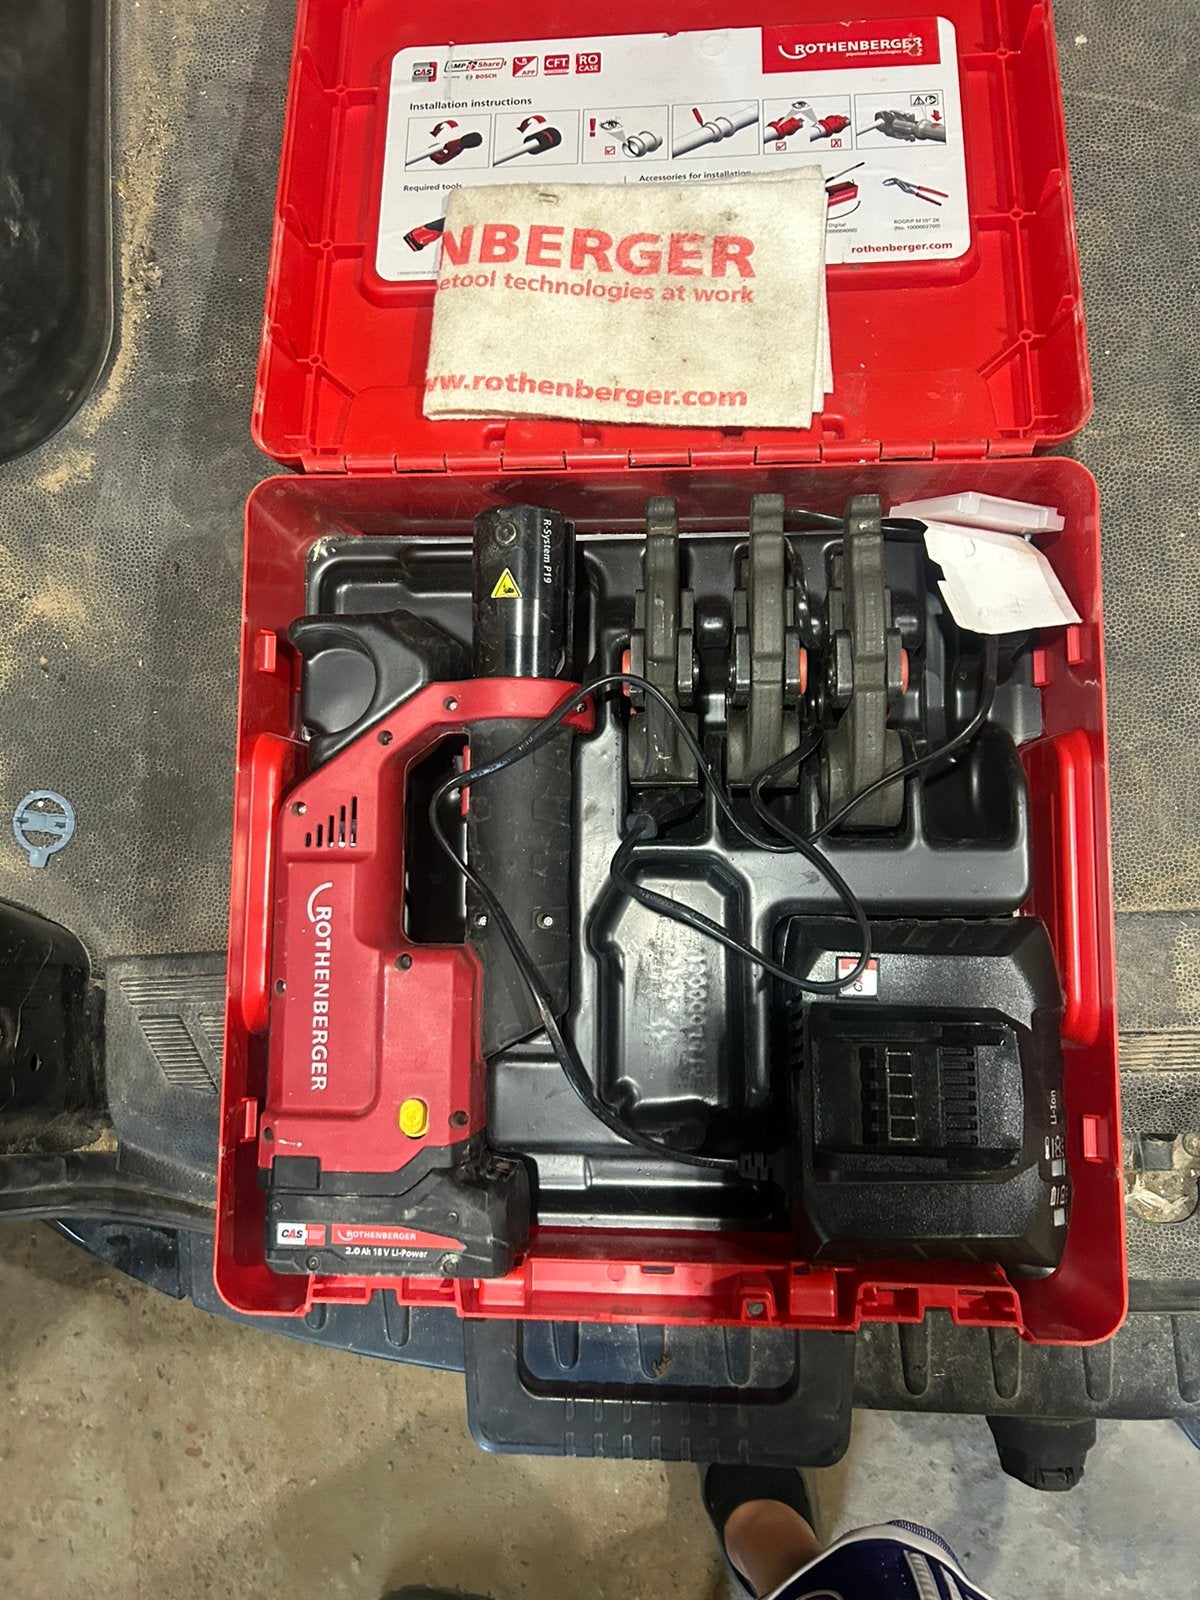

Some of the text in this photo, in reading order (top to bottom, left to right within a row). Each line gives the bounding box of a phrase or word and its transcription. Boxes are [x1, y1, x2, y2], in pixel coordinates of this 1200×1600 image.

[783, 37, 922, 58] ROTHENBERGER
[546, 57, 568, 68] CFT
[579, 54, 599, 64] RO
[413, 68, 432, 76] CAS
[409, 97, 532, 111] Installation instructions
[639, 173, 687, 182] Accessories
[703, 170, 752, 178] installation
[403, 182, 462, 192] Required tools
[851, 242, 953, 254] rothenberger.com
[439, 270, 755, 303] etool technologies at work
[541, 518, 552, 584] R-System P19
[307, 886, 334, 1092] ROTHENBERGER
[281, 1229, 303, 1239] CAS
[338, 1230, 417, 1241] ROTHENBERGER
[345, 1246, 360, 1255] 2.0
[361, 1247, 371, 1256] Ah
[373, 1248, 382, 1256] 18
